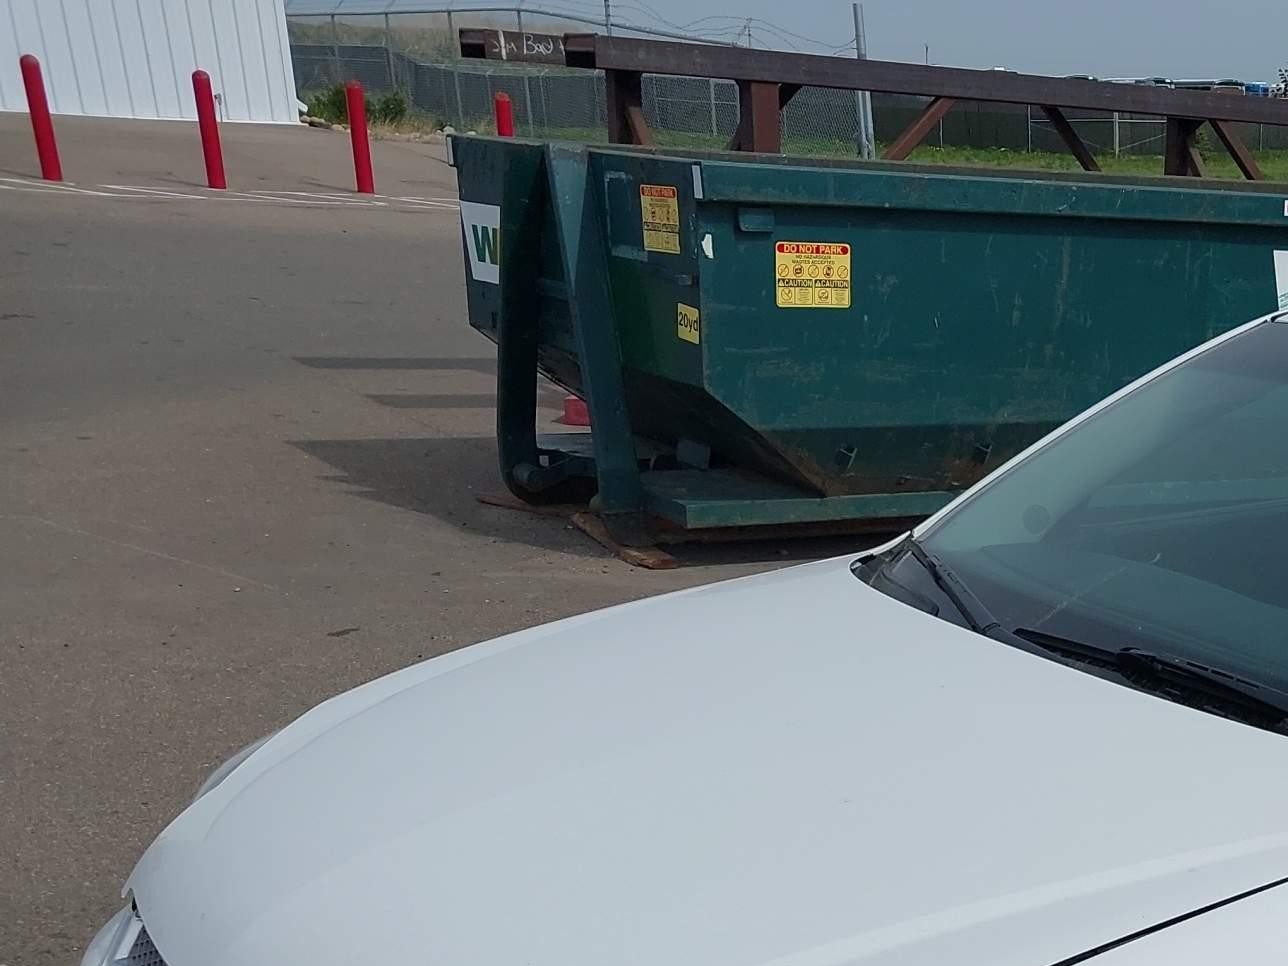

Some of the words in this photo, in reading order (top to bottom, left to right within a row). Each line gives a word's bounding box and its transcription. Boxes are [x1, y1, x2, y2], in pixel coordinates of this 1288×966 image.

[783, 244, 797, 253] DO
[799, 245, 819, 254] NOT
[820, 246, 843, 255] PARK
[784, 279, 813, 287] CAUTION
[822, 280, 848, 288] CAUTION
[678, 311, 699, 333] 20yd
